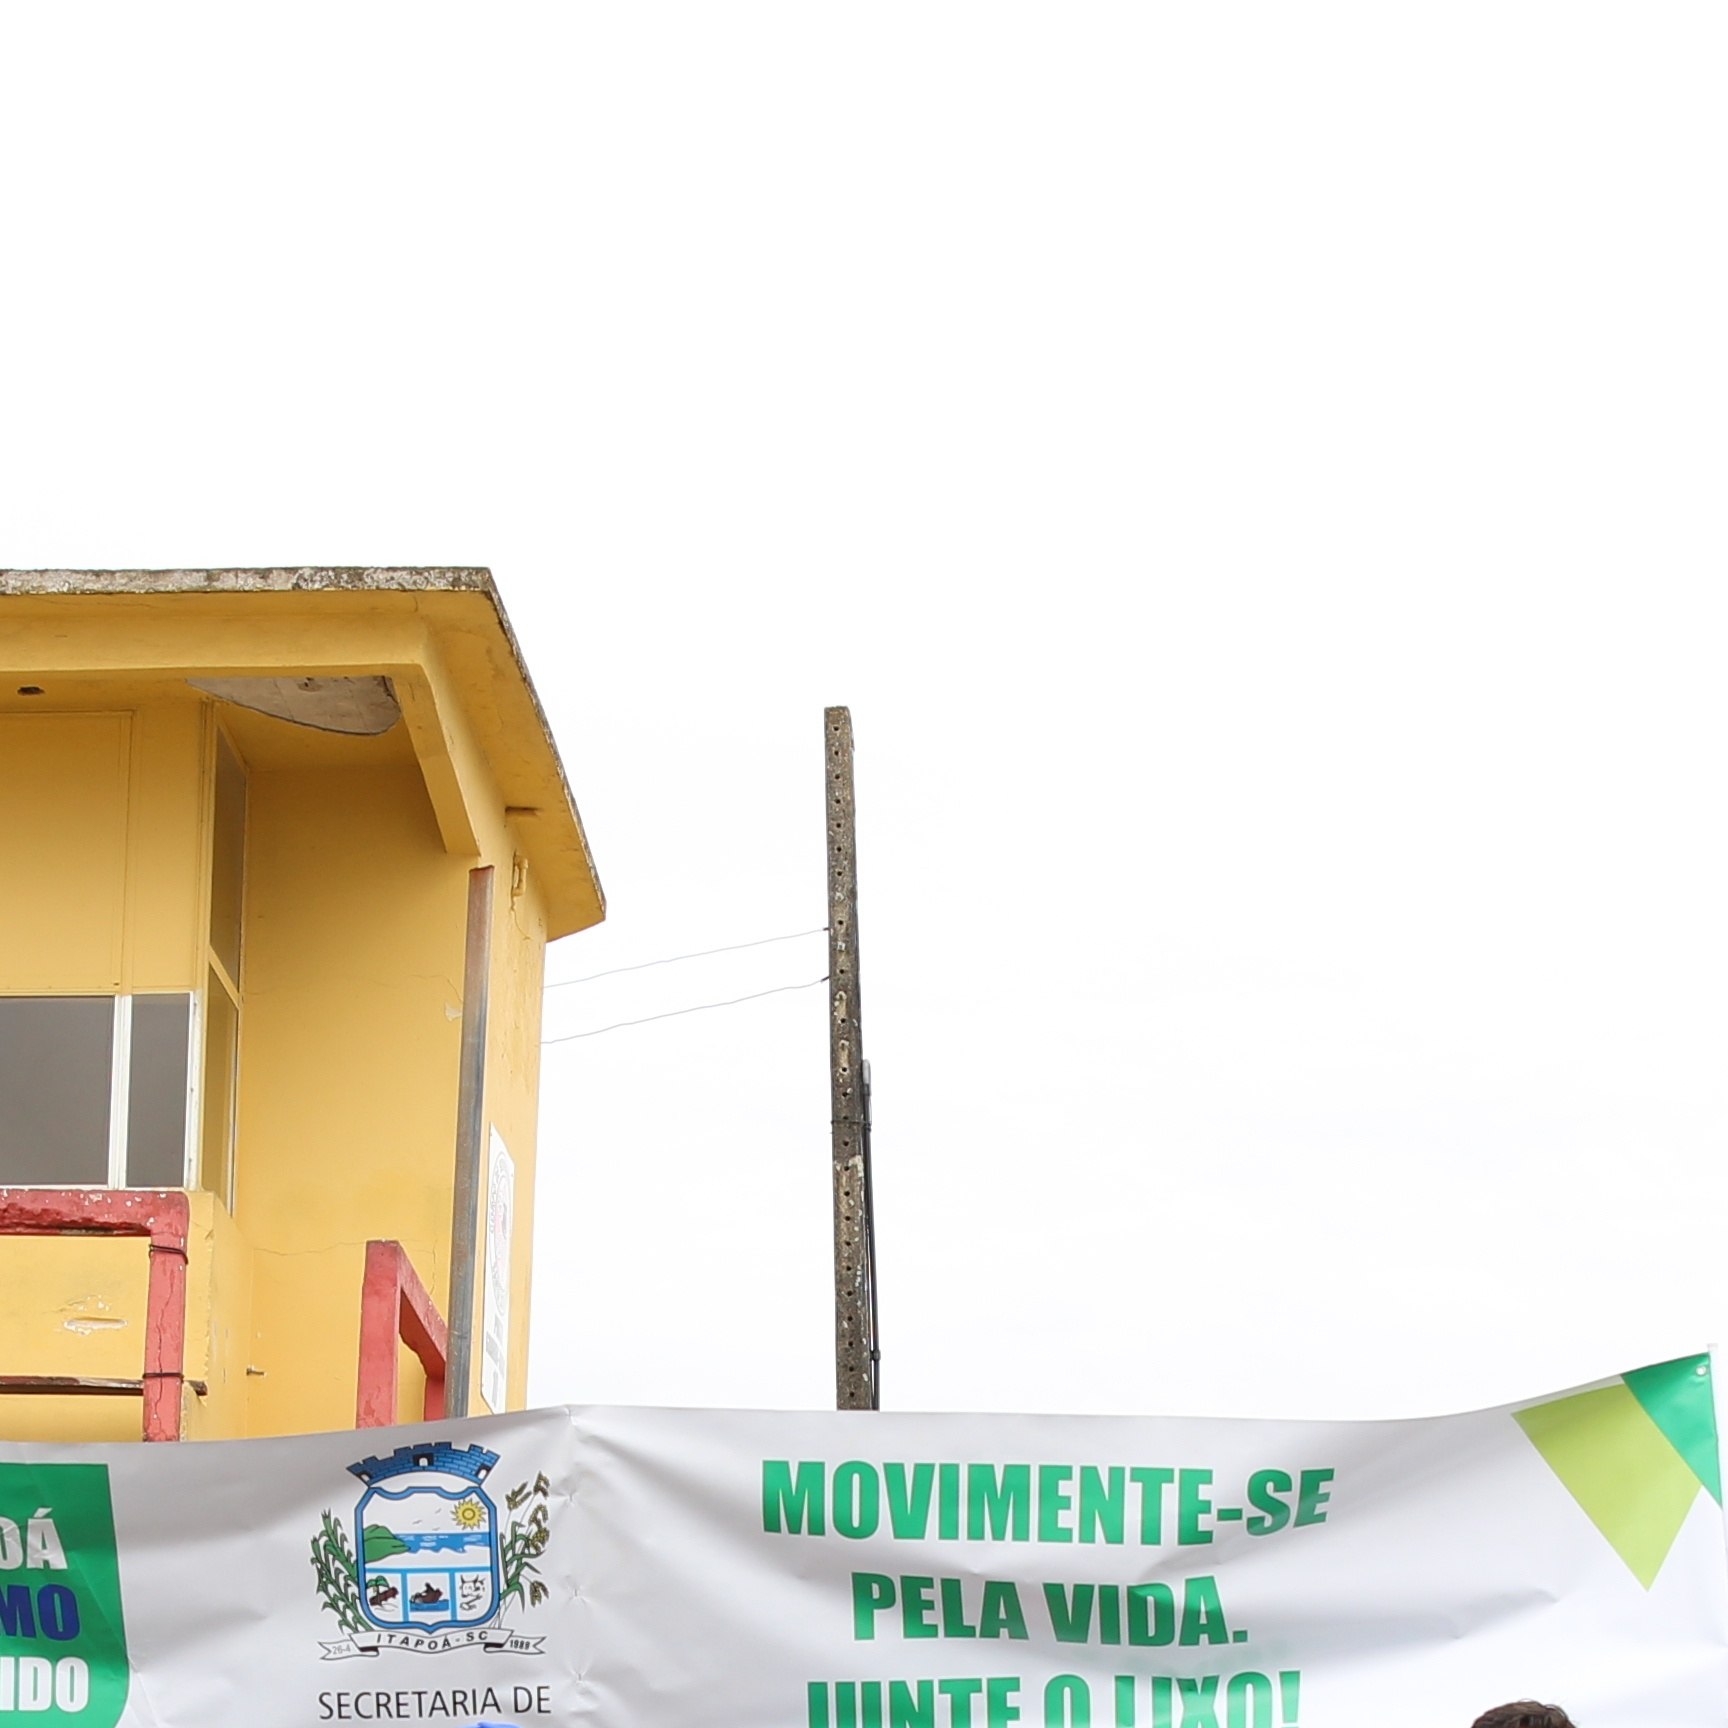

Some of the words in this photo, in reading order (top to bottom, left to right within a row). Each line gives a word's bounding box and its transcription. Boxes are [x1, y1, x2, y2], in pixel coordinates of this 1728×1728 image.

[762, 1460, 1335, 1546] MOVIMENTE-SE
[850, 1572, 1029, 1641] PELA
[1042, 1575, 1249, 1647] VIDA.
[318, 1687, 503, 1721] SECRETARIA
[513, 1685, 552, 1715] DE
